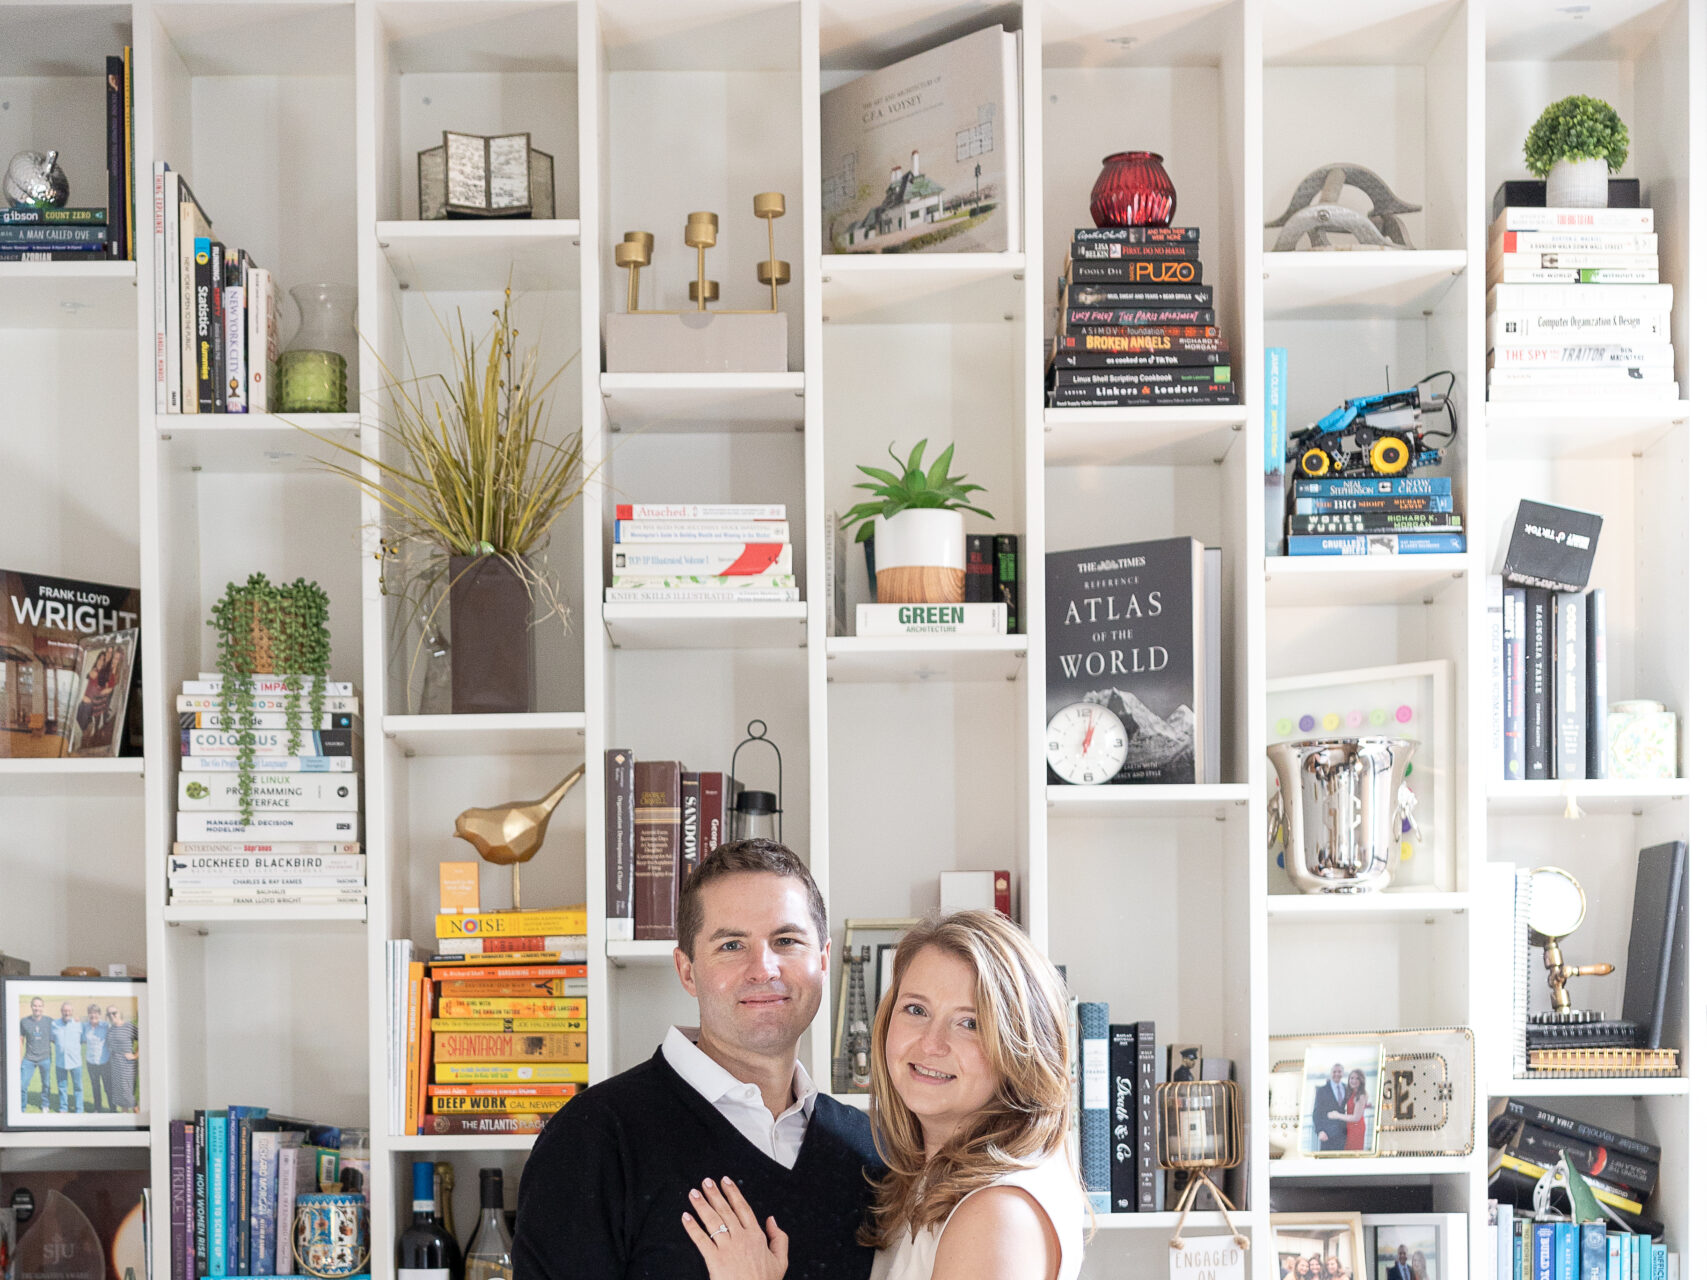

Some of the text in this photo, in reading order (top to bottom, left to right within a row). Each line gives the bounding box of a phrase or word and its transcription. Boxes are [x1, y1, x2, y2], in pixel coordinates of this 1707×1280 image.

[3, 211, 38, 222] gibson
[156, 197, 164, 234] EXPLAINER
[19, 230, 89, 239] A MAN CALLED OVE
[1085, 250, 1108, 258] BELKIN
[1143, 247, 1153, 255] DO
[1155, 247, 1164, 255] NO
[1165, 246, 1185, 255] HARM
[1136, 262, 1195, 282] PUZO
[185, 310, 191, 320] TO
[1071, 311, 1113, 322] LUCY FOLEY
[1119, 311, 1199, 322] THE PARIS APARTMENT
[1538, 316, 1640, 330] Computer Organization Design
[198, 286, 210, 380] Statistics dummies
[229, 291, 240, 374] NEW YORK CITY
[1081, 327, 1118, 335] ASIMOV
[1127, 327, 1165, 335] foundation
[1086, 336, 1171, 350] BROKEN ANGELS
[1505, 349, 1547, 360] THE SPY
[1561, 347, 1606, 362] TRAITOR
[1073, 374, 1172, 384] Linux Shell Scripting Cookbook
[1271, 352, 1279, 405] JAMIE OLIVER
[1096, 385, 1198, 396] Linkers & Loaders
[1330, 485, 1374, 495] STEPHENSON
[1334, 500, 1356, 509] BIG
[1309, 515, 1362, 523] WOKEN
[1308, 523, 1364, 532] FURIES
[1524, 524, 1555, 540] TikTok
[1322, 540, 1365, 548] CRUELLEST
[1078, 556, 1146, 573] THE TIMES
[1084, 576, 1140, 589] REFERENCE
[38, 586, 110, 607] FRANK LLOYD
[611, 592, 639, 600] KNIFE
[641, 592, 671, 600] SKILLS
[673, 592, 734, 600] ILLUSTRATED
[10, 595, 137, 634] WRIGHT
[898, 606, 964, 624] GREEN
[1064, 591, 1163, 625] ATLAS
[1566, 604, 1576, 641] COOK
[1092, 628, 1133, 642] OF THE
[1059, 646, 1169, 679] WORLD
[1077, 708, 1091, 717] 12
[1113, 739, 1123, 748] 3
[261, 776, 290, 784] LINUX
[684, 796, 697, 861] SANDOW
[191, 858, 322, 867] LOCKHEED BLACKBIRD
[450, 919, 505, 933] NOISE
[448, 1035, 512, 1056] SHANTARAM
[437, 1098, 506, 1108] DEEP WORK
[1114, 1076, 1132, 1139] Death &
[1142, 1063, 1151, 1167] HARVEST
[1536, 1111, 1574, 1128] ZIMA BLUE
[462, 1119, 518, 1130] THE ATLANTIS
[173, 1167, 185, 1214] PRINCE
[214, 1158, 223, 1257] PERMISSION TO SCREW UP
[196, 1173, 205, 1258] HOW WOMEN RISE
[1175, 1250, 1239, 1269] ENGAGED
[1541, 1238, 1549, 1269] BUILD
